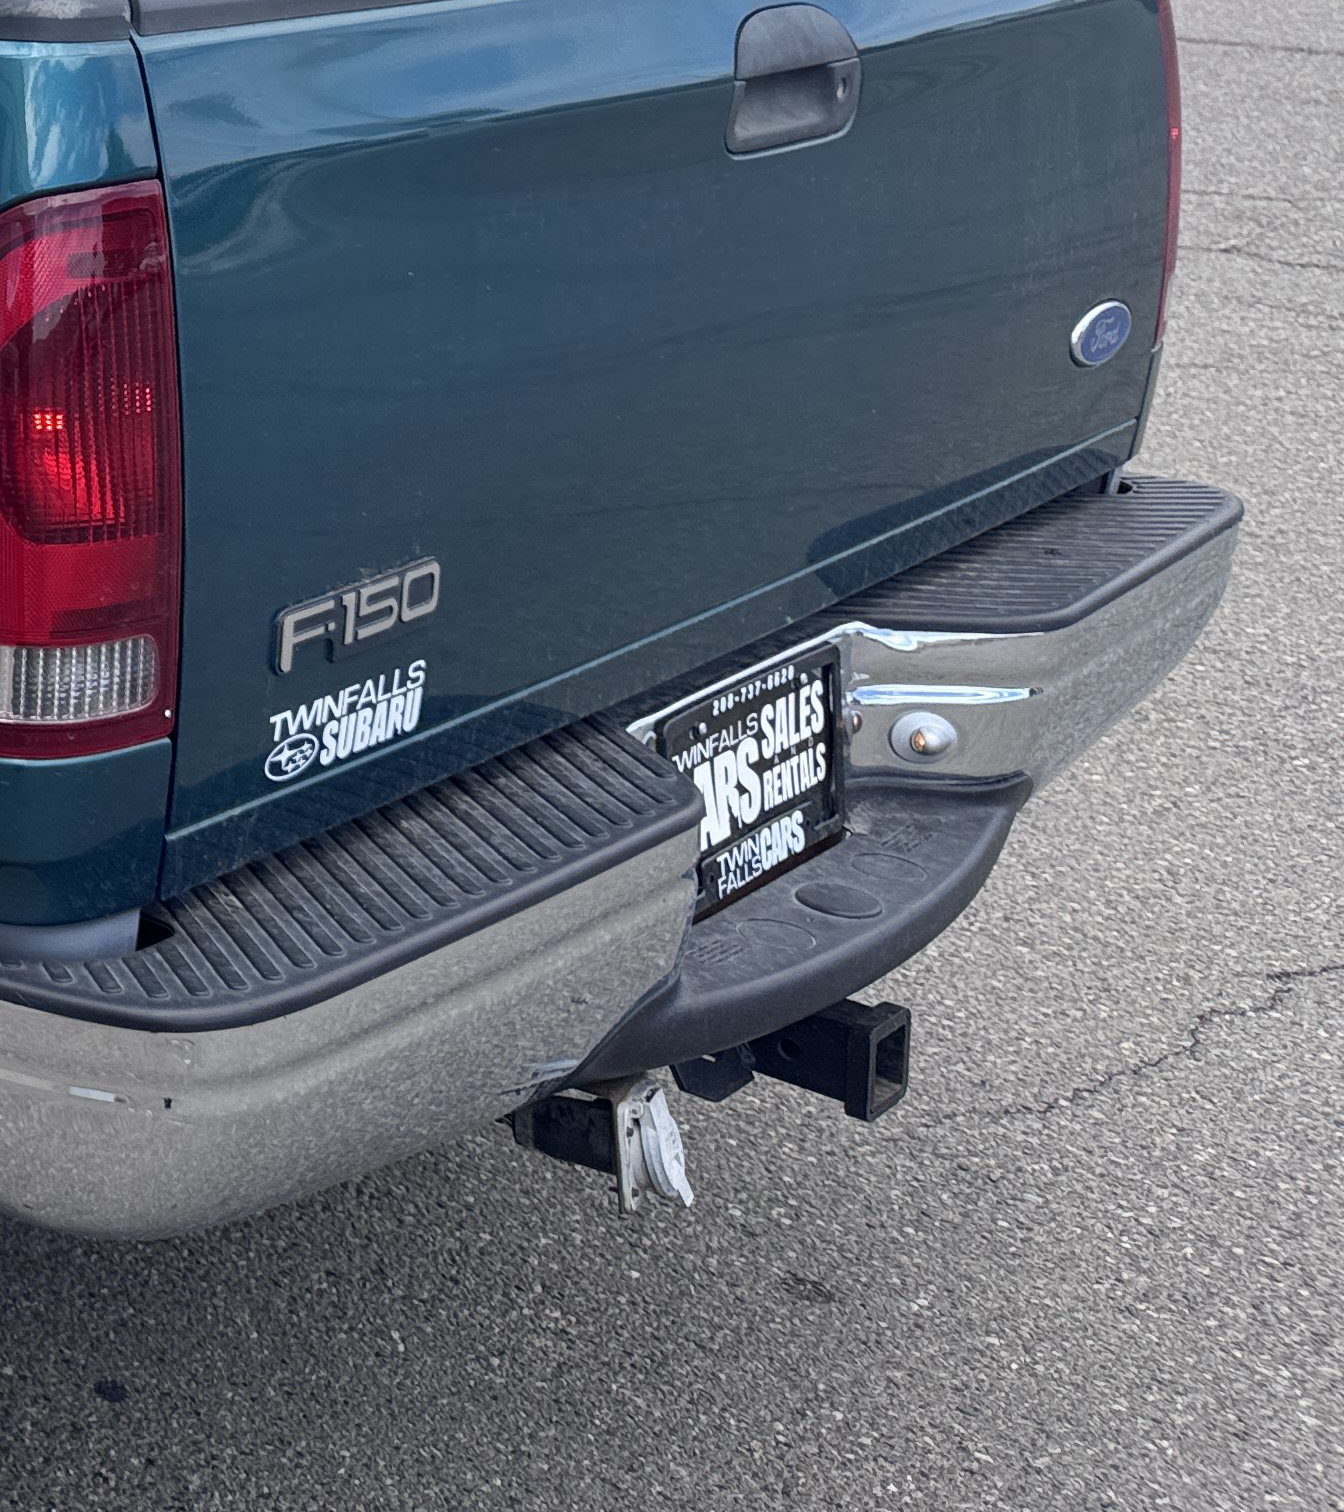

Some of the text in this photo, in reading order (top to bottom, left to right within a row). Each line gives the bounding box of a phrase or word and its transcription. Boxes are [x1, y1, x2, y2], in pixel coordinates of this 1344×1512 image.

[270, 659, 427, 741] TWINFALLS
[319, 687, 424, 766] SUBARU
[761, 680, 824, 760] SALES
[672, 712, 759, 772] WINFALLS
[762, 742, 827, 811] RENTALS
[694, 737, 761, 851] ARS
[716, 833, 761, 877] TWIN
[761, 810, 806, 871] CARS
[717, 854, 762, 899] FALLS
